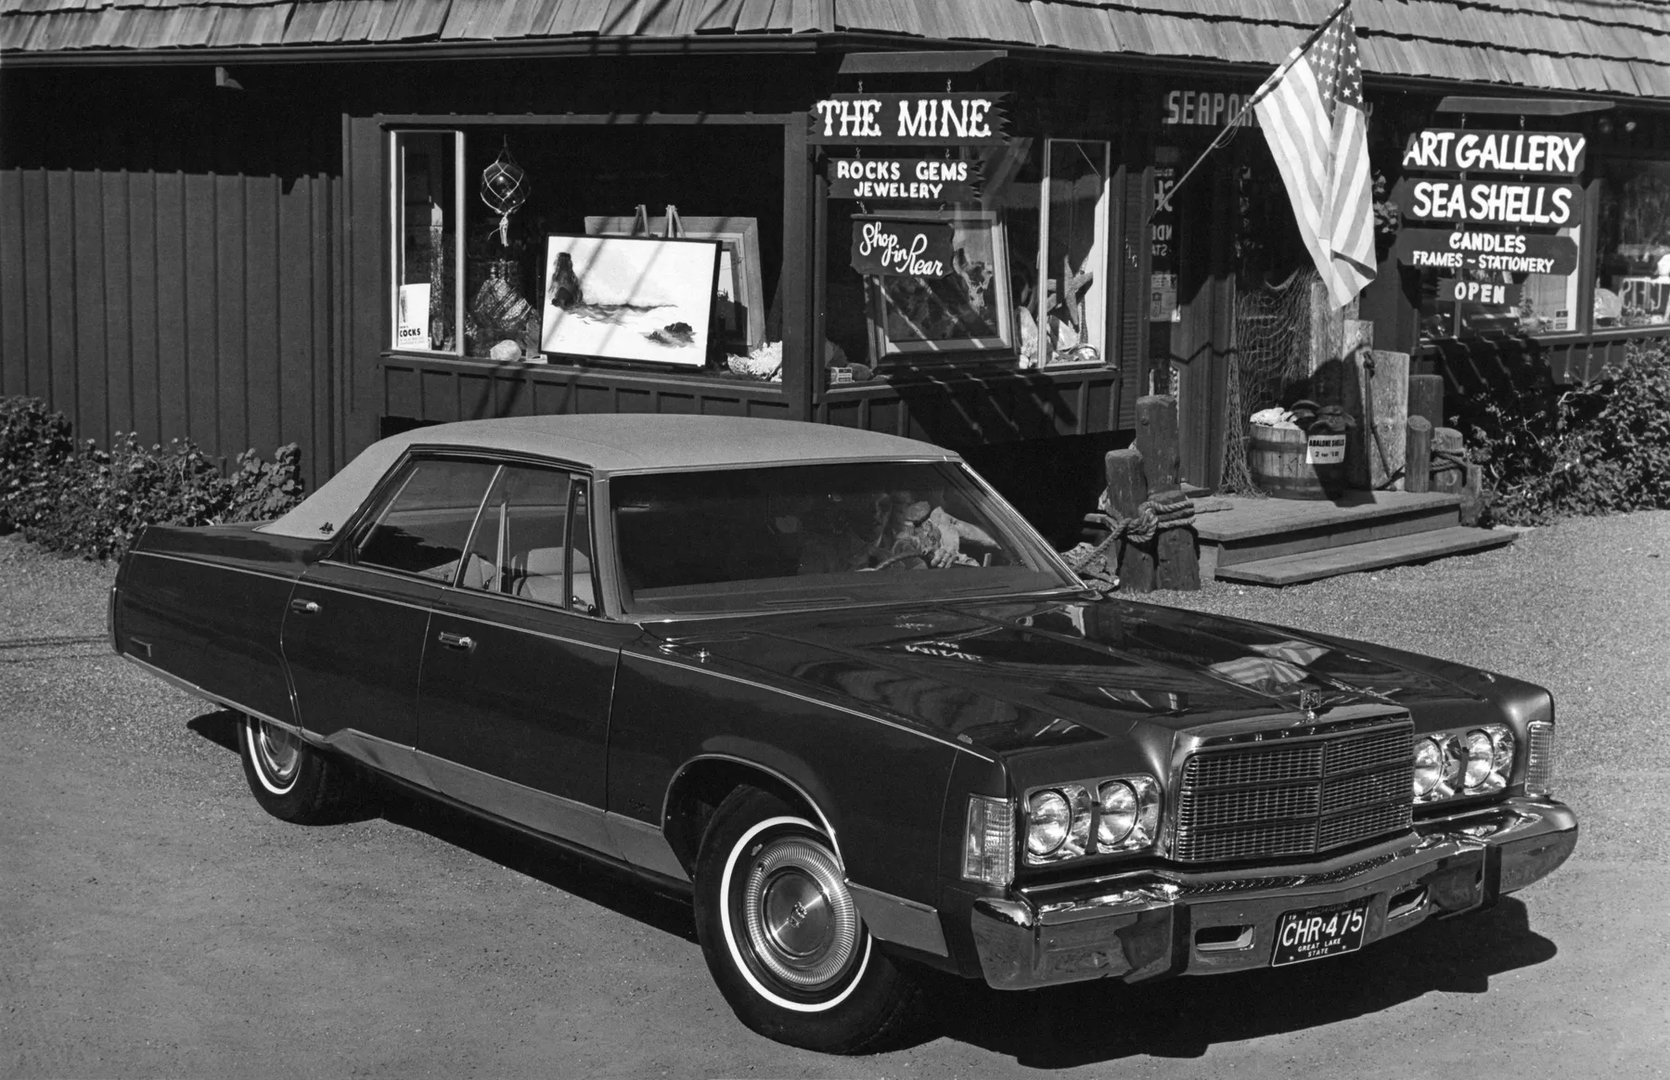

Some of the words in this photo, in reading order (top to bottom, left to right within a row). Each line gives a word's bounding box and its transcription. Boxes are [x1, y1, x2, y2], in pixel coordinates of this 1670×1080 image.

[816, 99, 882, 137] THE
[897, 99, 992, 137] MINE
[1165, 90, 1260, 127] SEAPOR
[1402, 130, 1455, 167] ART
[1455, 133, 1586, 173] GALLERY
[837, 160, 901, 180] ROCKS
[916, 161, 968, 181] GEMS
[853, 181, 944, 199] JEWELERY
[859, 221, 900, 267] Shop
[893, 244, 908, 263] in
[1449, 231, 1526, 254] CANDLES
[896, 233, 944, 276] Rear
[1413, 250, 1463, 268] FRAMES
[1478, 255, 1555, 274] STATIONERY
[1454, 281, 1505, 304] OPEN
[1298, 942, 1320, 953] GREAT
[1324, 937, 1341, 947] LAKE
[1308, 947, 1328, 957] STATE
